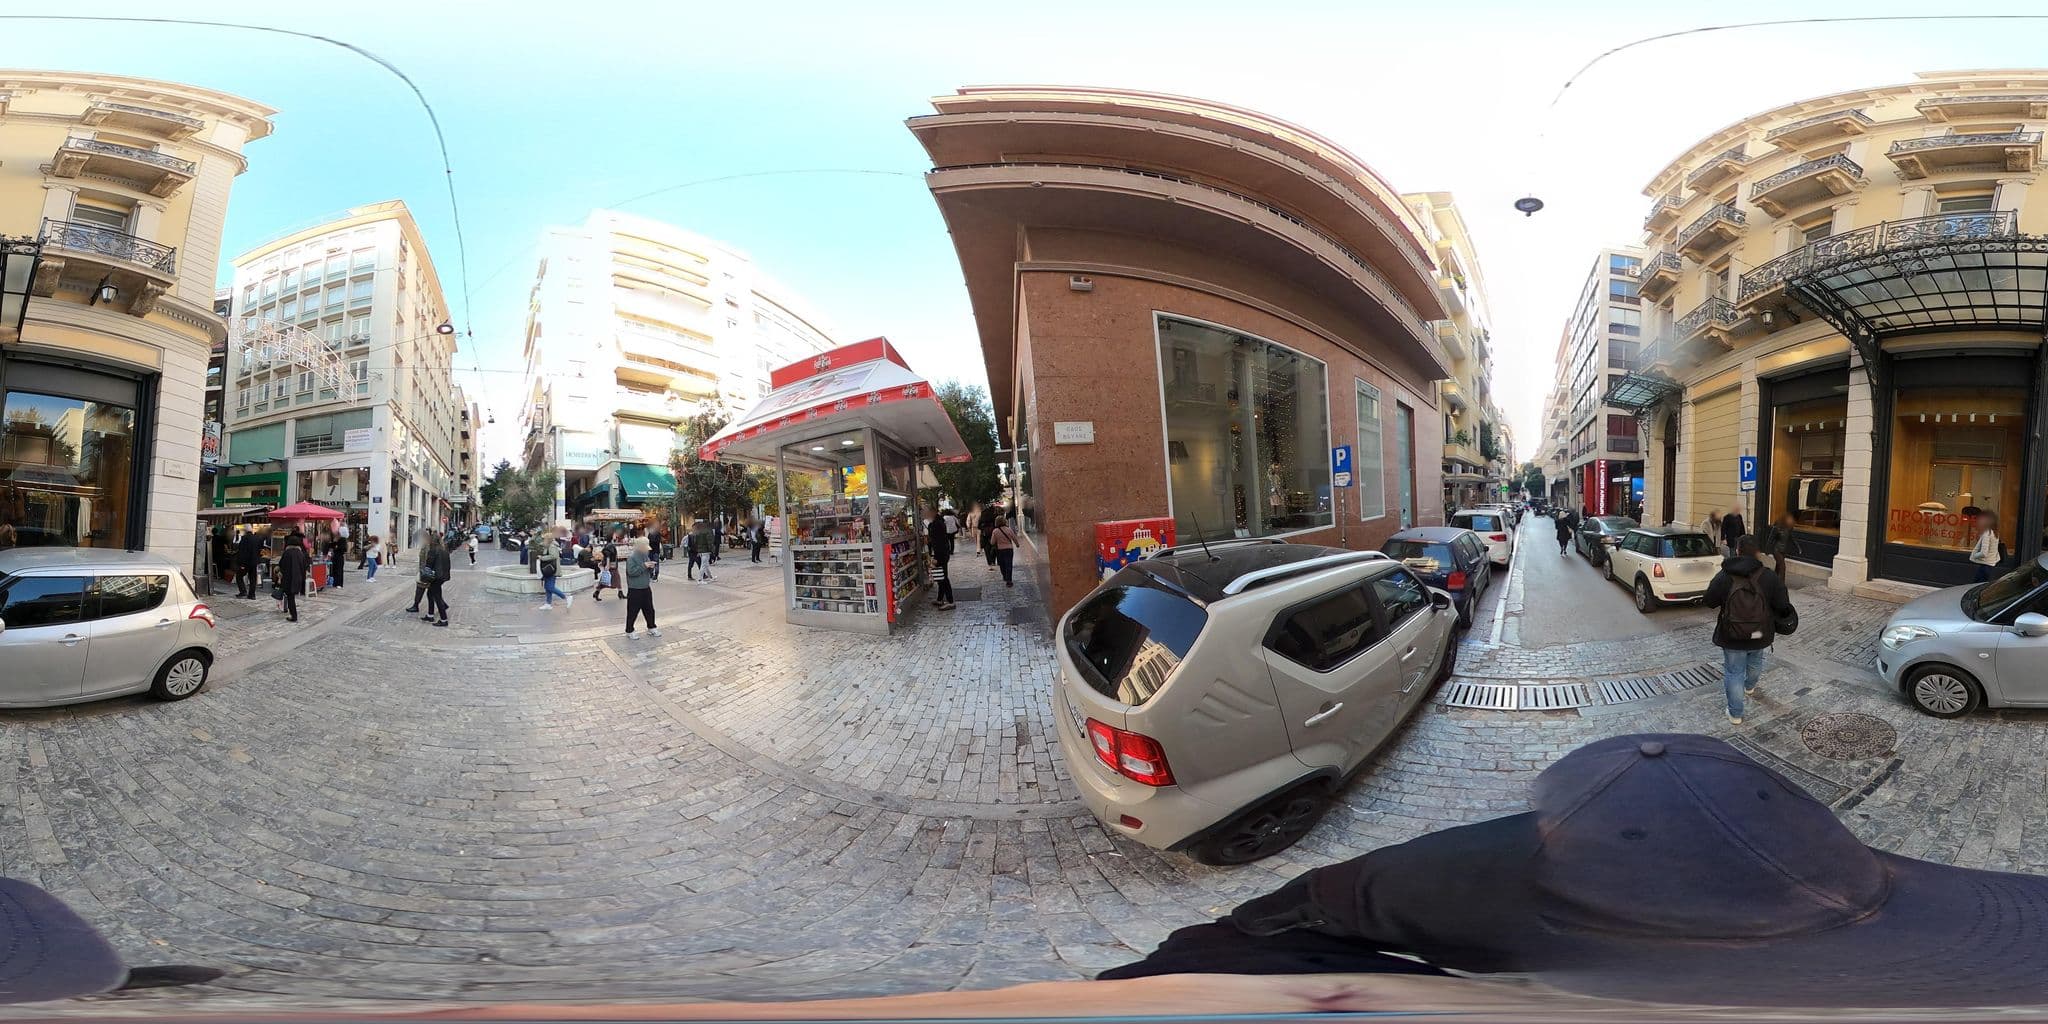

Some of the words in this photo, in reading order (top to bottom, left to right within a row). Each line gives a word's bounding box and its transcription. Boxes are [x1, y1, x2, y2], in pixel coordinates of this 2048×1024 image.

[1336, 448, 1347, 467] P
[1743, 460, 1754, 478] P
[1891, 508, 1978, 528] ΠΡΟΣΦΟΡΕ
